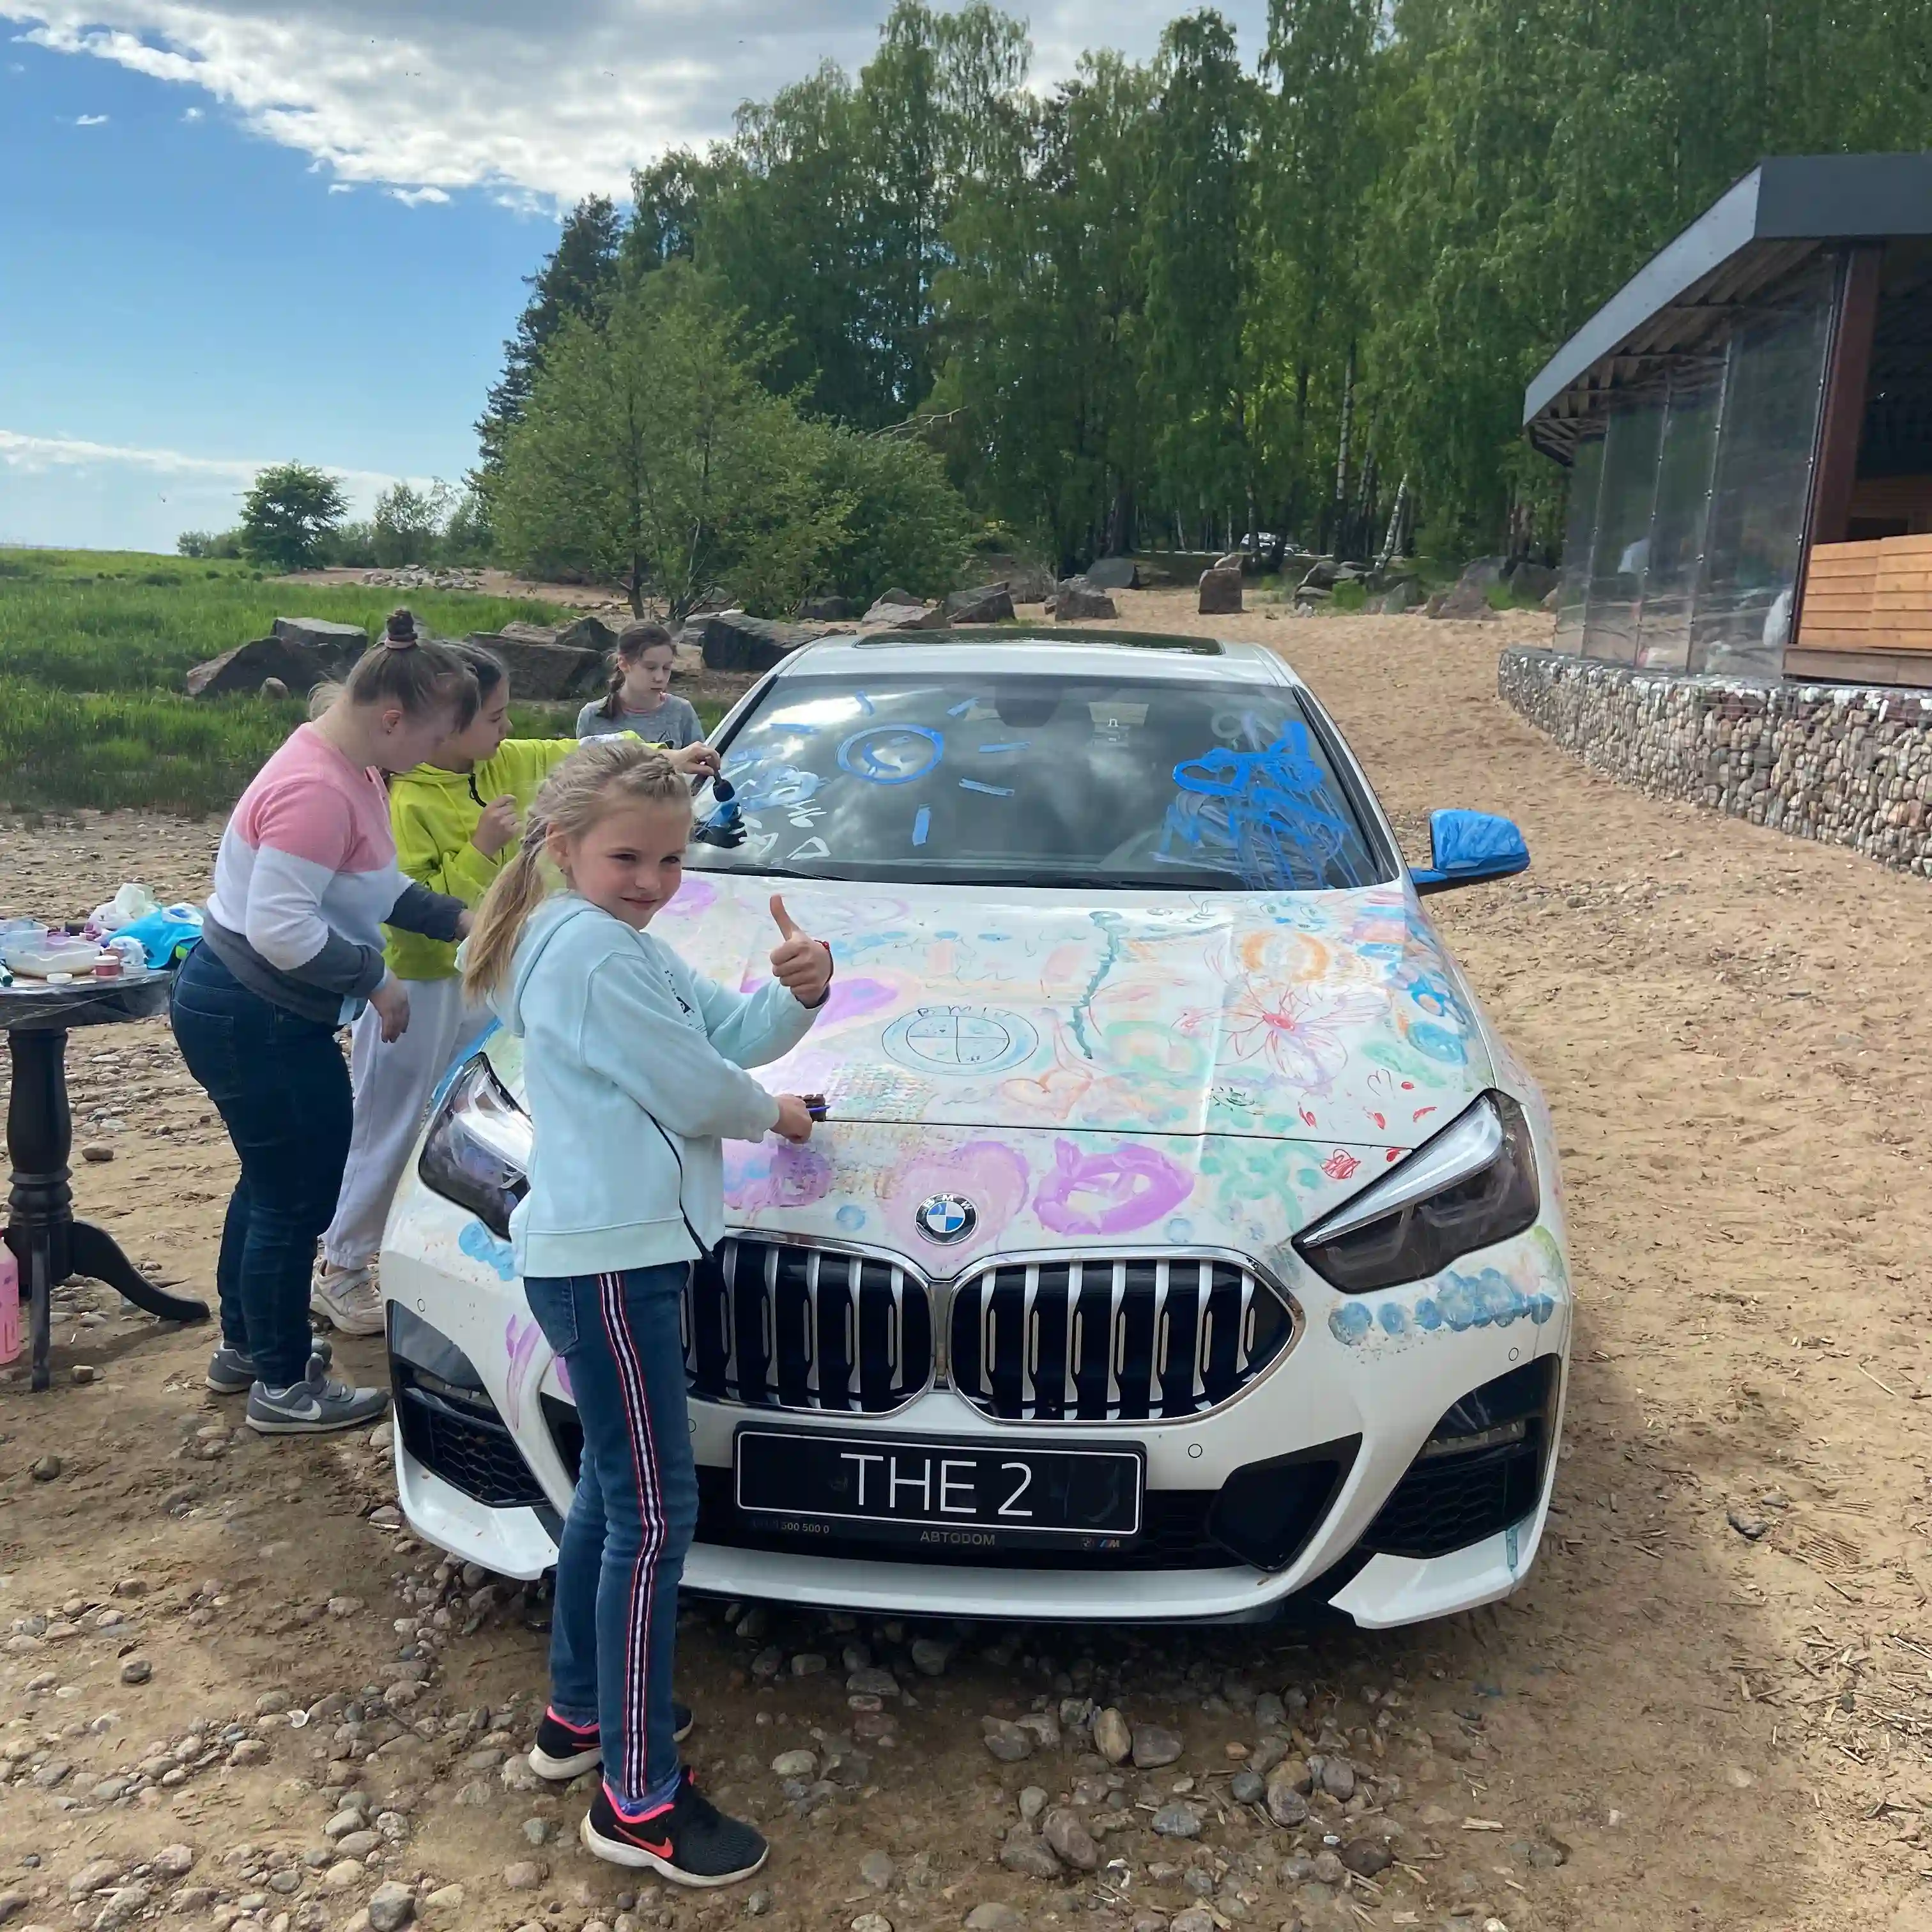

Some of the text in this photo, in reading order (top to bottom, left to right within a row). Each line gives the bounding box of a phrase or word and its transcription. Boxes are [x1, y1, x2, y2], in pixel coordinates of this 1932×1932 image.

[922, 1194, 973, 1211] BMW
[840, 1452, 1032, 1516] THE 2
[802, 1523, 820, 1533] 500
[823, 1524, 830, 1534] 0
